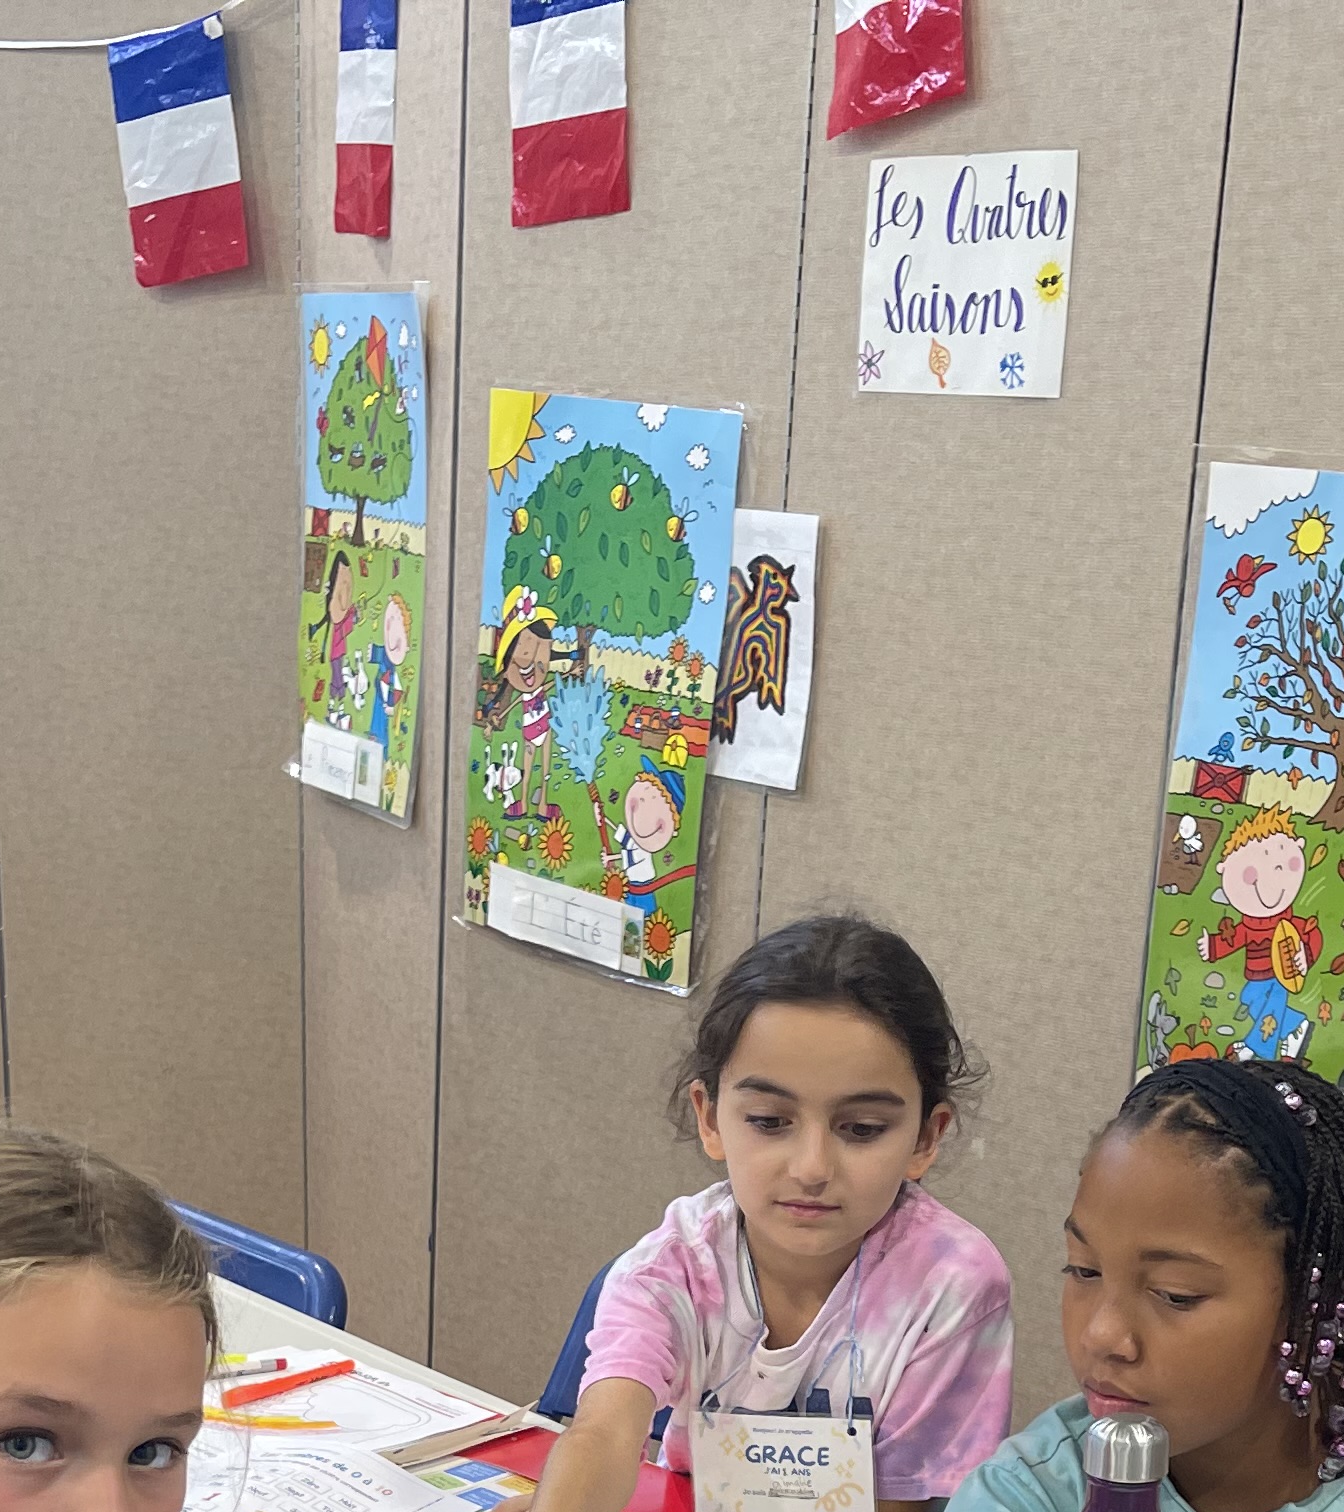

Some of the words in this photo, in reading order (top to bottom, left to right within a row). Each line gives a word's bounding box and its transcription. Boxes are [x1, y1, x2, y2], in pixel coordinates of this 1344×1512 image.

[869, 164, 924, 248] Les
[884, 254, 1025, 335] Saisons
[745, 1443, 830, 1467] GRACE
